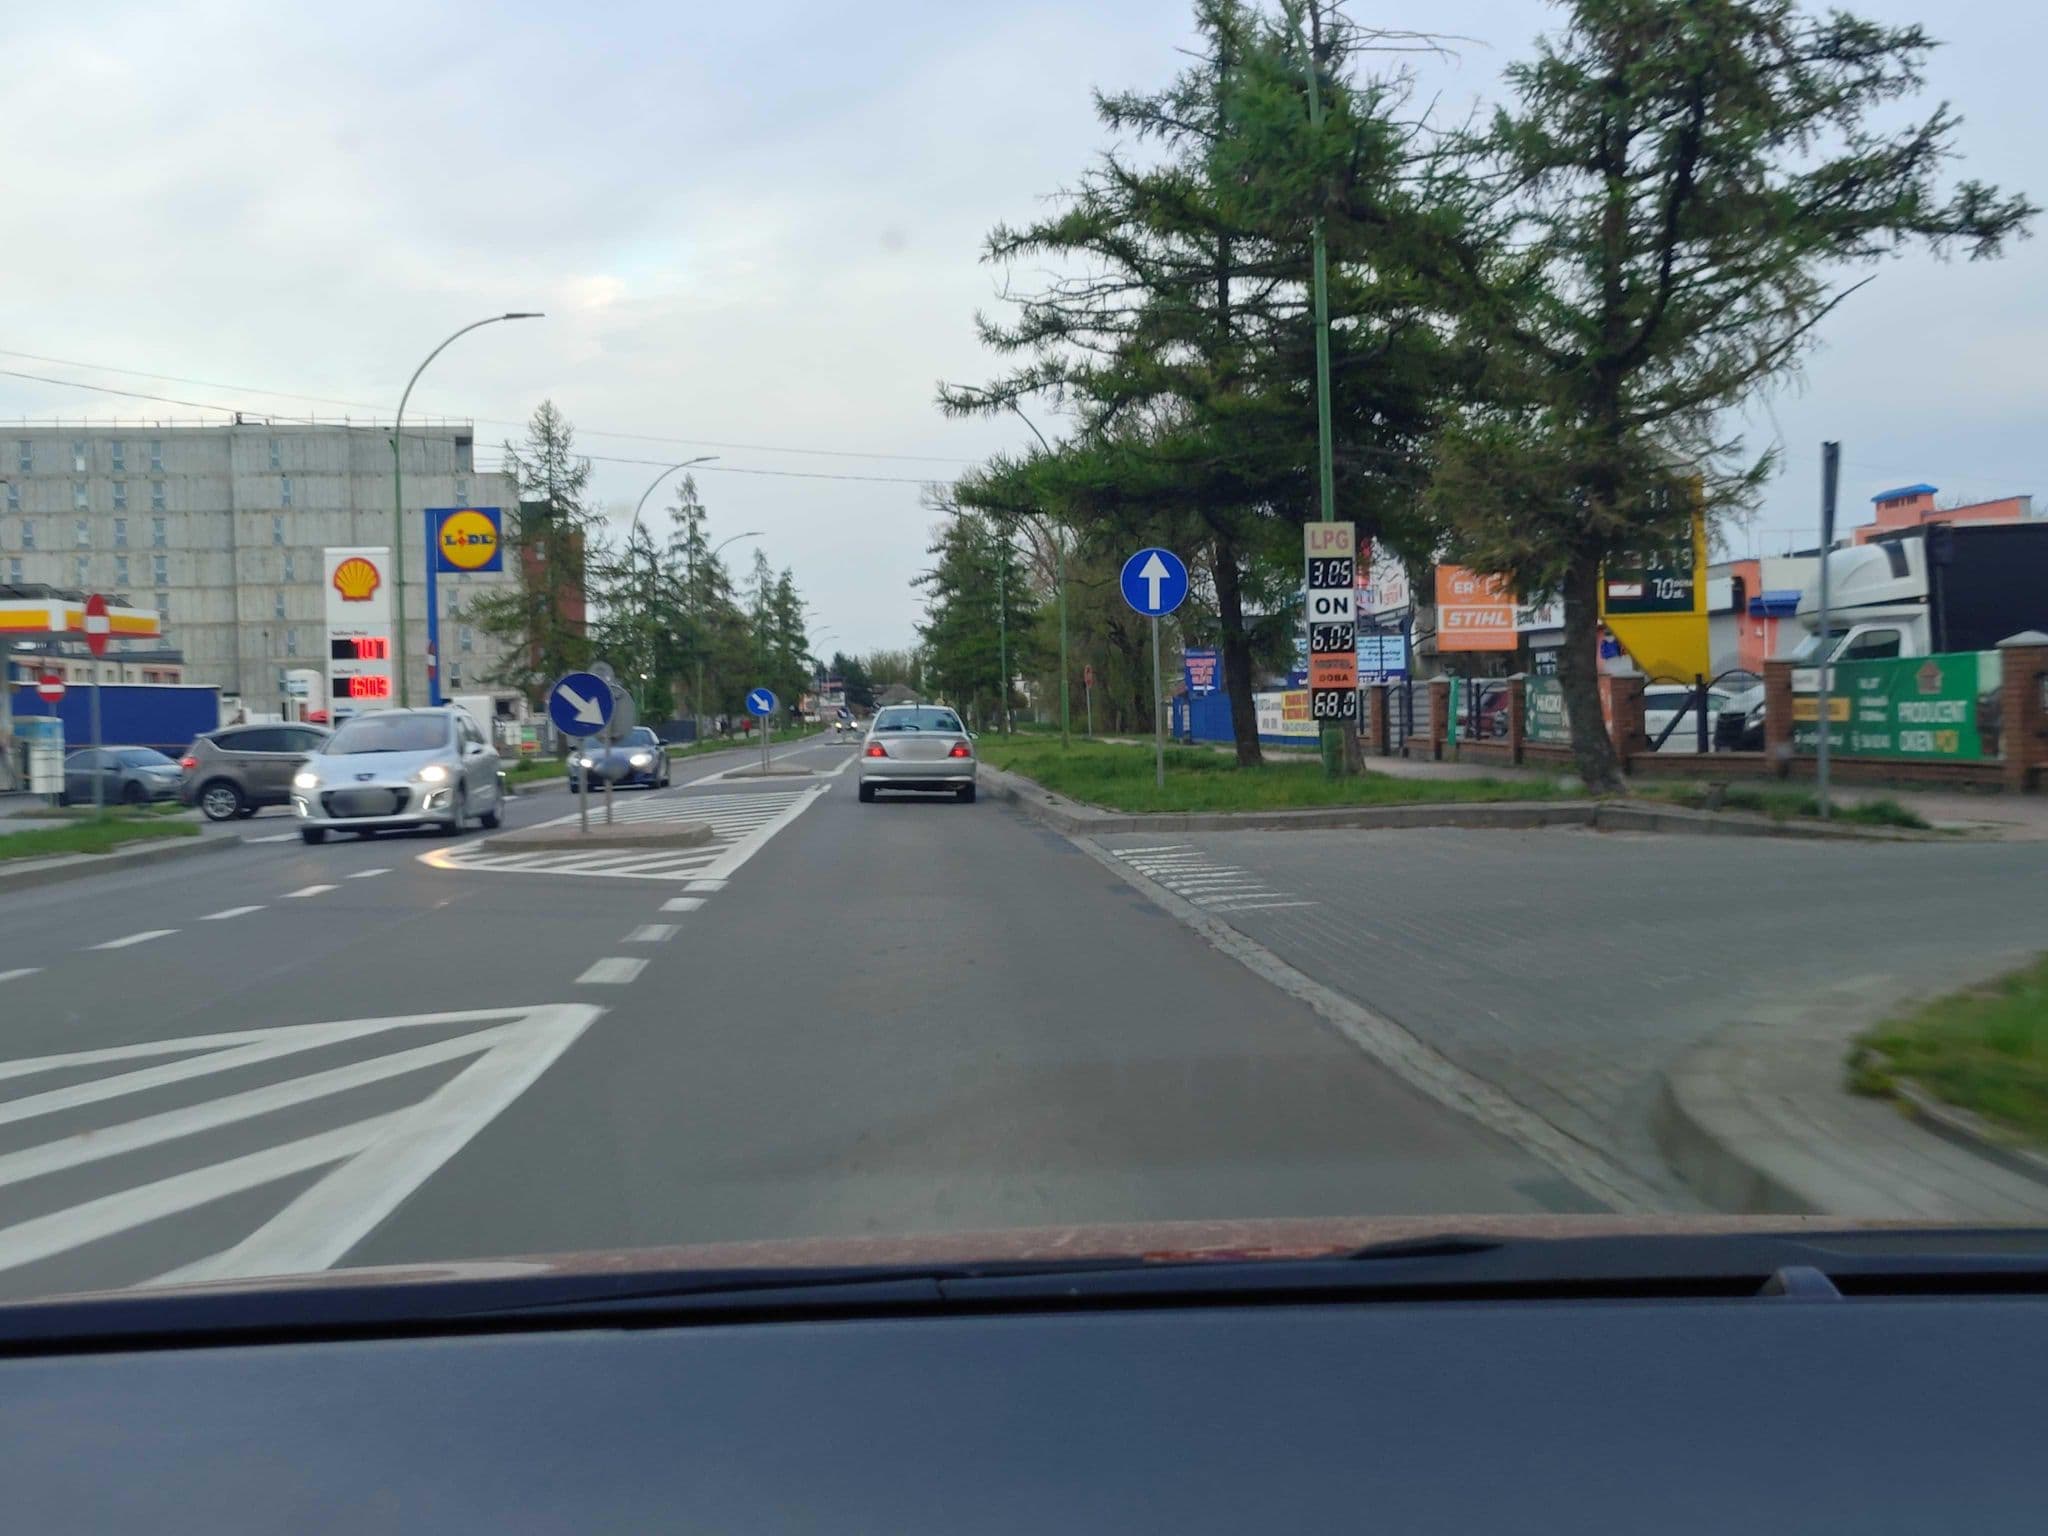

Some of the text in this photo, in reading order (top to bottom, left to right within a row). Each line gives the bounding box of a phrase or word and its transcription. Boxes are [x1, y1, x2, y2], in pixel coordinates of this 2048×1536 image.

[1311, 530, 1350, 550] LPG
[1315, 597, 1348, 615] ON
[1447, 610, 1509, 628] STIHL
